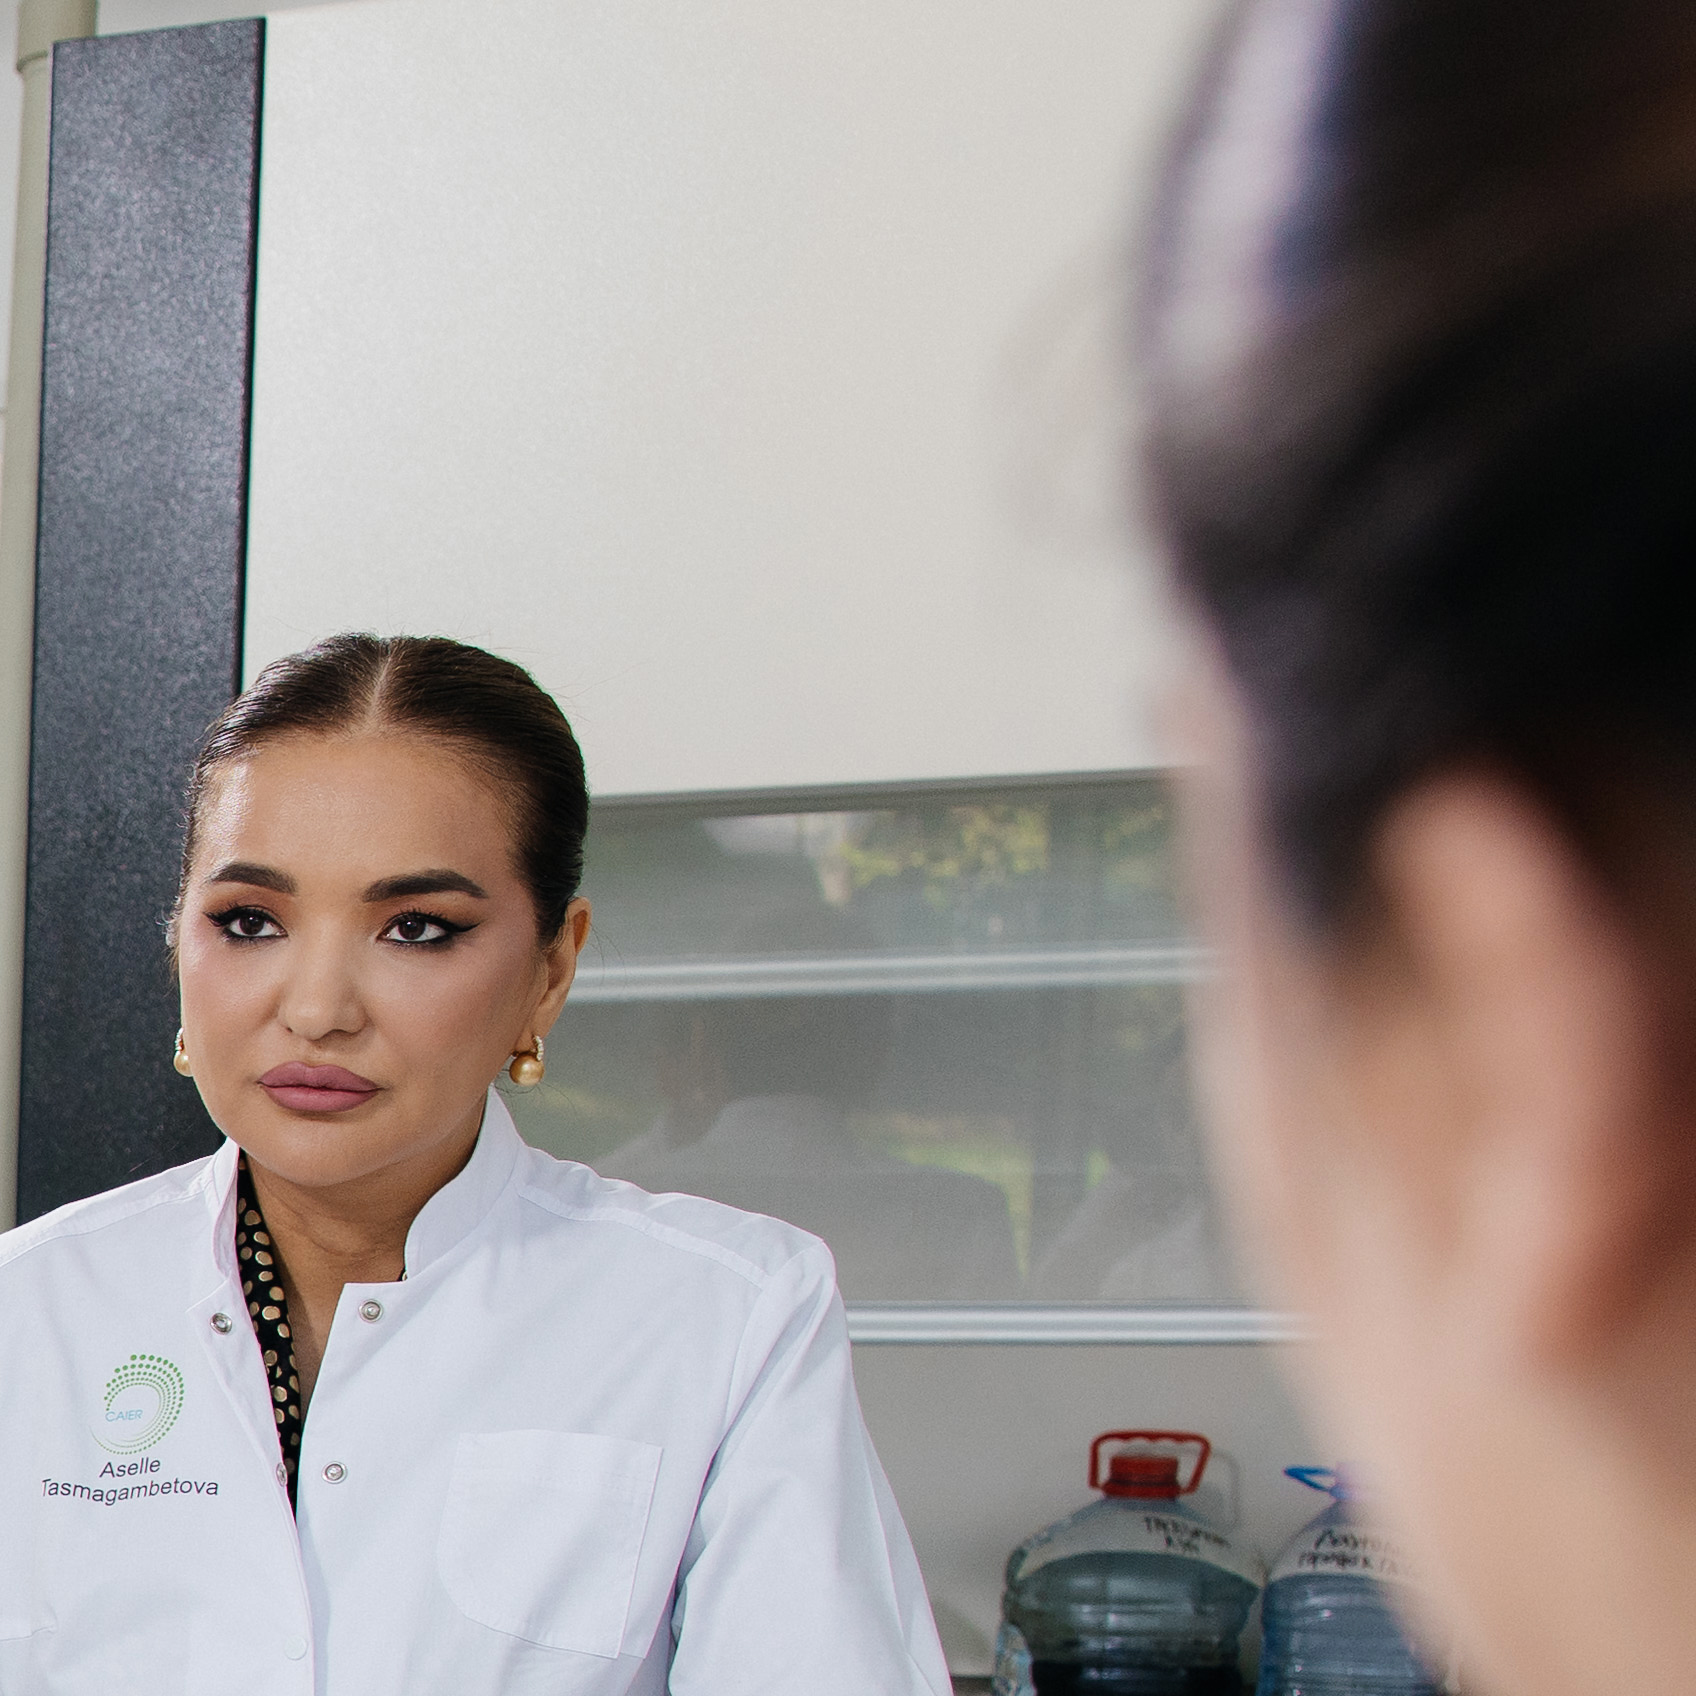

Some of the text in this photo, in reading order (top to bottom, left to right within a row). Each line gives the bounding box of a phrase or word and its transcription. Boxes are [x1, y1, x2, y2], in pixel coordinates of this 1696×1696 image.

[105, 1409, 143, 1422] CAIER
[99, 1457, 161, 1478] Aselle
[42, 1477, 219, 1506] Tasmagambetova
